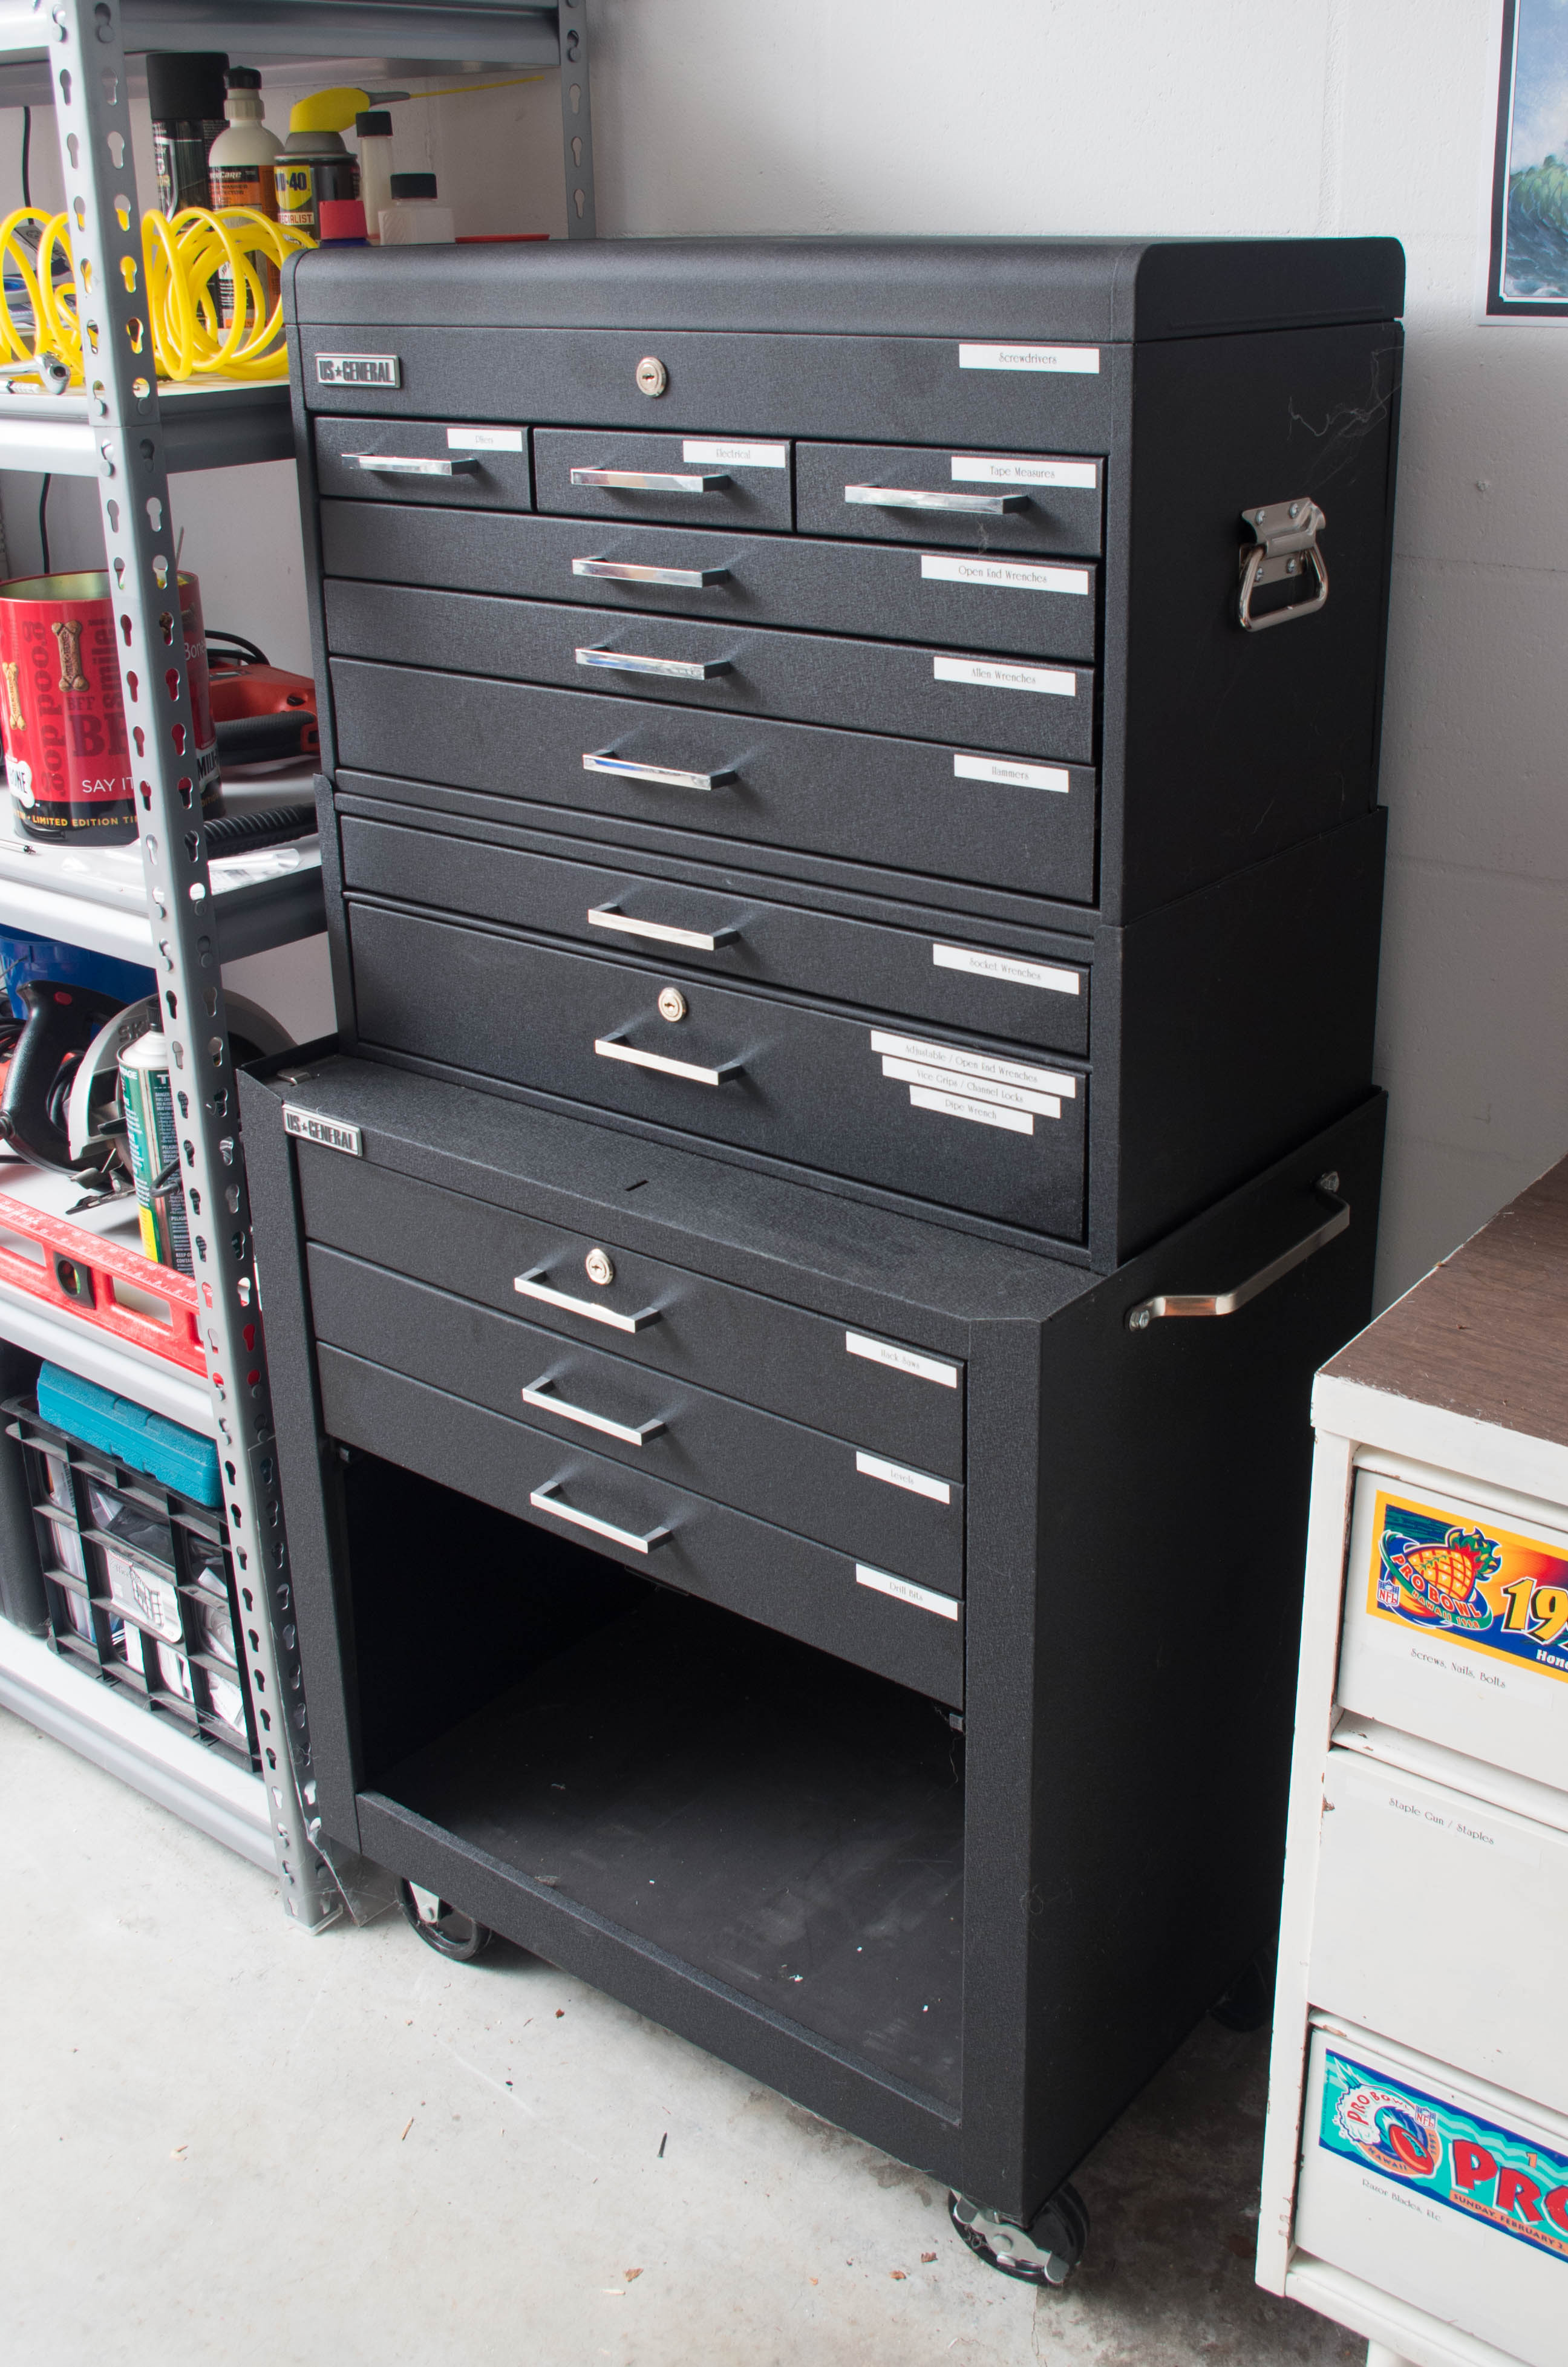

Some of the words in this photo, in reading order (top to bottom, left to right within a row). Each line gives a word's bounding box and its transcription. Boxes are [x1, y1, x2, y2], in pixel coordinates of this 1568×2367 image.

[278, 214, 313, 224] ECIALIST
[999, 352, 1057, 364] Screwdrivers
[342, 361, 394, 383] GENERAL
[716, 449, 751, 459] Electrical
[990, 465, 1011, 477] Tape
[1014, 467, 1056, 479] Measures
[958, 566, 983, 577] Open
[987, 568, 1002, 579] End
[1005, 570, 1048, 583] Wrenches
[972, 668, 991, 679] Allen
[995, 670, 1036, 684] Wrenches
[991, 765, 1030, 780] Hammers
[82, 778, 116, 793] SAY
[122, 776, 134, 791] IT
[33, 815, 68, 827] LIMITED
[71, 817, 119, 828] EDITION
[969, 958, 998, 971] Socket
[1001, 963, 1041, 980] Wrenches
[905, 1045, 946, 1061] Adjustable
[955, 1056, 978, 1071] Open
[981, 1062, 996, 1074] End
[998, 1066, 1038, 1083] Wrenches
[917, 1069, 933, 1082] Vice
[936, 1074, 958, 1088] Grips
[967, 1082, 999, 1097] Channel
[1002, 1090, 1024, 1103] Locks
[968, 1105, 997, 1120] Wrench
[308, 1120, 357, 1152] GENERAL
[881, 1348, 898, 1362] Hack
[890, 1469, 915, 1485] Levels
[889, 1581, 906, 1595] Drill
[909, 1589, 924, 1601] Bits
[1390, 1553, 1425, 1592] PRO
[1428, 1583, 1481, 1618] BOWL
[1379, 1589, 1398, 1604] NFL
[1411, 1590, 1452, 1622] HAWAII
[1456, 1617, 1480, 1629] 1998
[1500, 1576, 1568, 1648] 19
[1411, 1648, 1447, 1669] Screws,
[1451, 1662, 1475, 1679] Nails,
[1480, 1672, 1506, 1688] Bolts
[1389, 1798, 1421, 1815] Staple
[1424, 1811, 1444, 1825] Gun
[1456, 1824, 1495, 1845] Staples
[1347, 2094, 1370, 2126] PRO
[1369, 2091, 1411, 2111] BOWL
[1416, 2113, 1436, 2127] NFL
[1368, 2147, 1408, 2170] HAWAII
[1362, 2178, 1388, 2196] Razor
[1500, 2216, 1555, 2245] FEBRUARY
